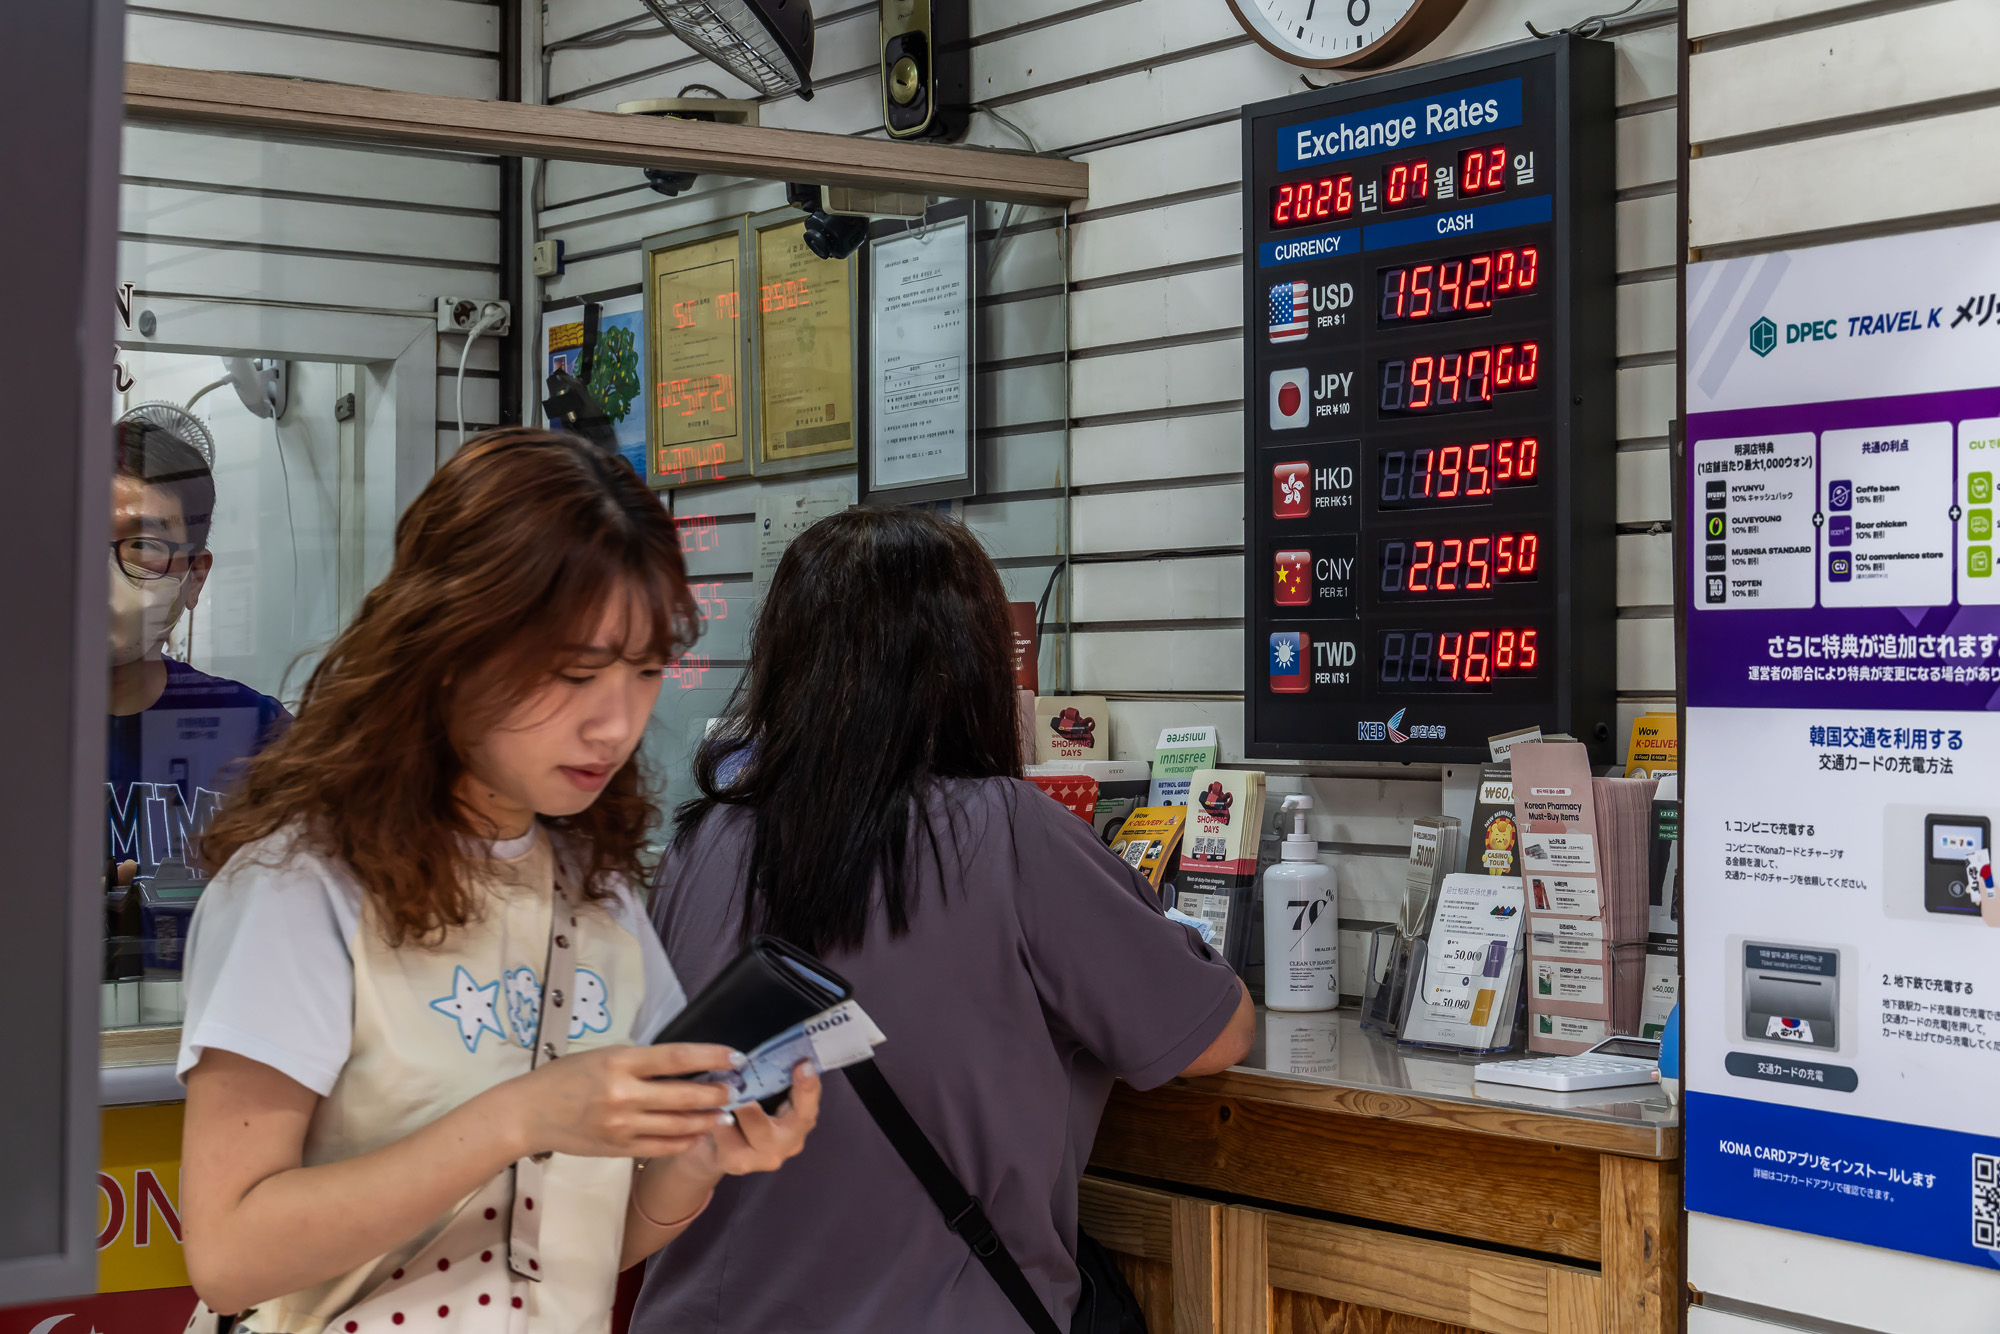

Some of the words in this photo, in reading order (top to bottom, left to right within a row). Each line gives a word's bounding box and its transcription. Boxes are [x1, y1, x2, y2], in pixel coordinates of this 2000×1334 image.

[1297, 115, 1416, 160] Exchange
[1426, 99, 1499, 135] Rates
[1275, 177, 1352, 222] 2026
[1360, 181, 1377, 212] 년
[1389, 164, 1428, 202] 07
[1434, 166, 1454, 200] 월
[1465, 149, 1506, 190] 02
[1513, 152, 1534, 185] 일
[1437, 214, 1474, 234] CASH
[1275, 236, 1341, 261] CURRENCY
[1312, 282, 1354, 311] USD
[1317, 315, 1332, 328] PER
[1786, 319, 1837, 344] DPEC
[1848, 310, 1922, 337] TRAVEL
[1927, 307, 1943, 328] K
[1950, 293, 2000, 329] メリ
[1314, 372, 1353, 400] JPY
[1316, 405, 1332, 417] PER
[1861, 438, 1909, 454] 共通の利点
[1969, 441, 1986, 450] CU
[1315, 467, 1353, 490] HKD
[1732, 484, 1765, 492] NYUNYU
[1316, 497, 1330, 508] PER
[1732, 494, 1746, 502] 10%
[1732, 515, 1782, 524] OLIVEYOUNG
[1876, 520, 1907, 528] chicken
[1856, 531, 1871, 539] 10%
[1732, 548, 1767, 556] MUSINSA
[1769, 546, 1811, 555] STANDARD
[1869, 553, 1920, 561] convenience
[1732, 558, 1746, 566] 10%
[1316, 557, 1354, 581] CNY
[1313, 641, 1356, 667] TWD
[1315, 672, 1331, 684] PER
[1358, 721, 1386, 741] KEB
[1638, 727, 1659, 736] Wow
[1052, 740, 1091, 748] SHOPPING
[1636, 739, 1677, 749] K-DELIVER
[1809, 725, 1963, 751] 韓国交通を利用する
[1061, 749, 1082, 757] DAYS
[1819, 753, 1954, 775] 交通カードの充電方法
[1524, 802, 1547, 810] Korean
[1548, 801, 1582, 812] Pharmacy
[1197, 815, 1228, 824] SHOPPING
[1528, 812, 1559, 823] Must-Buy
[1560, 813, 1579, 821] Items
[1203, 825, 1219, 834] DAYS
[1734, 821, 1815, 837] コンビニで充電する
[1894, 974, 1973, 995] 地下鉄で充電する
[1757, 1062, 1824, 1083] 交通カードの充電
[1719, 1140, 1752, 1157] KONA
[1754, 1146, 1936, 1188] CARDアプリをインストールします
